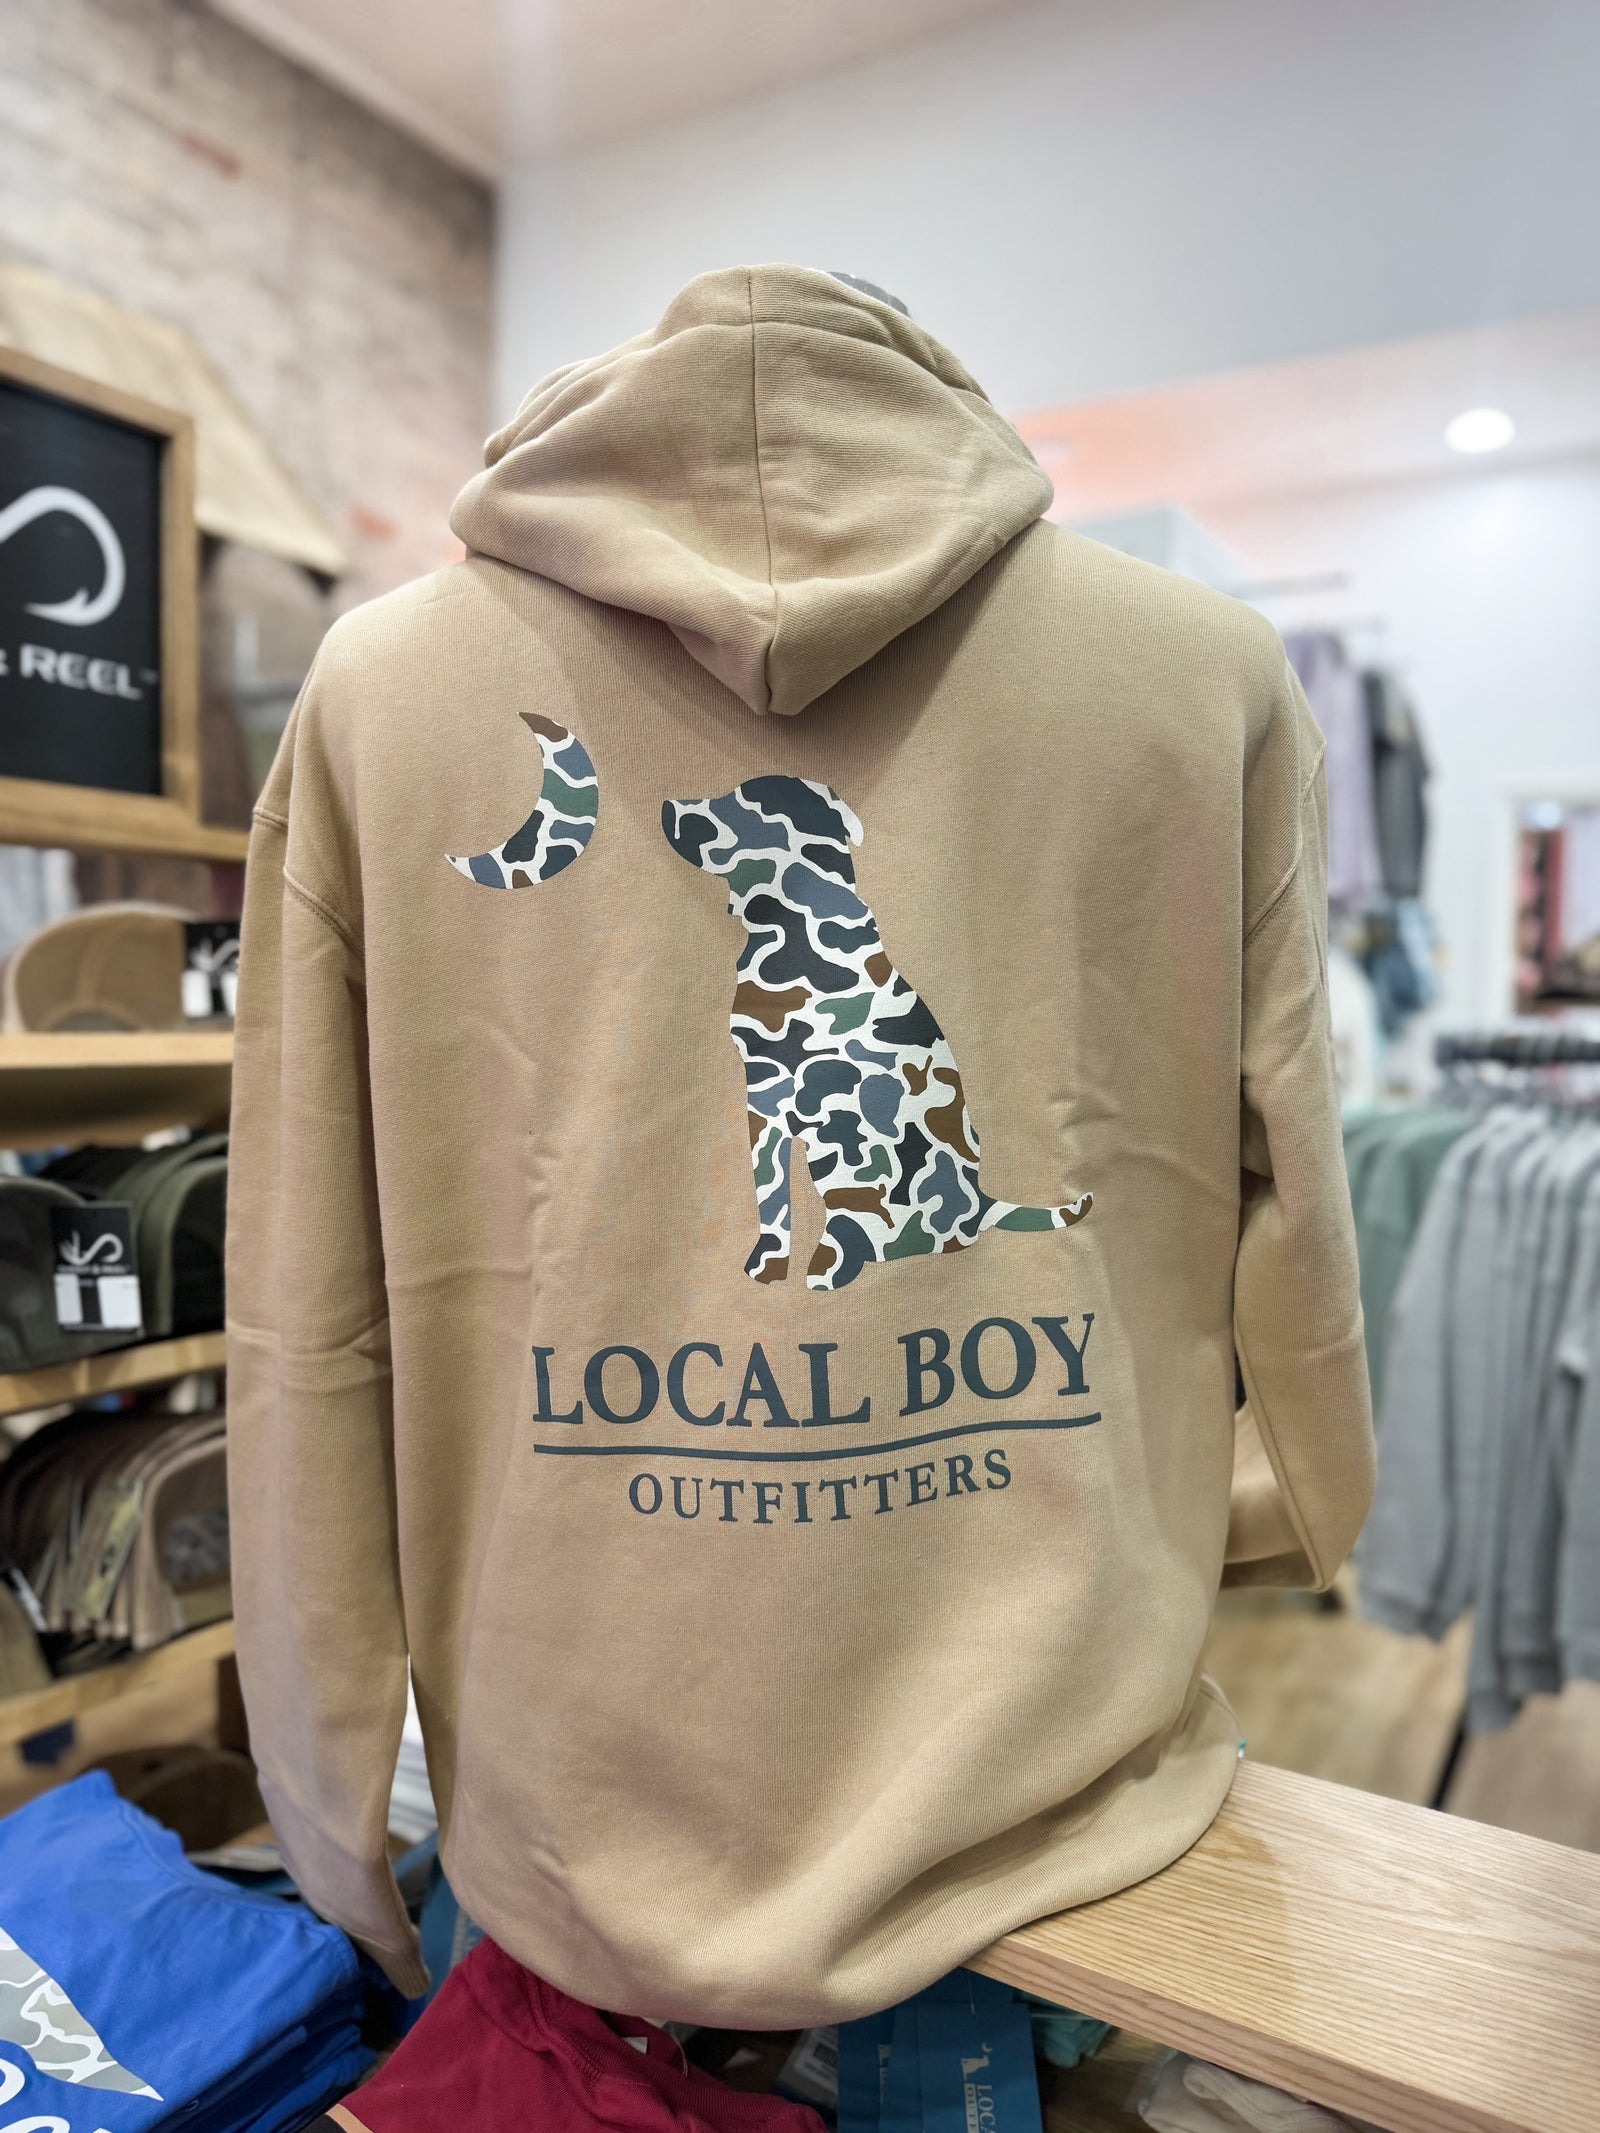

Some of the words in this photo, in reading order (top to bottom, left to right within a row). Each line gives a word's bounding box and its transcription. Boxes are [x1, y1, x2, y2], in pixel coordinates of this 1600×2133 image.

[531, 1342, 870, 1428] LOCAL
[897, 1312, 1096, 1417] BOY
[627, 1448, 1012, 1524] OUTFITTERS
